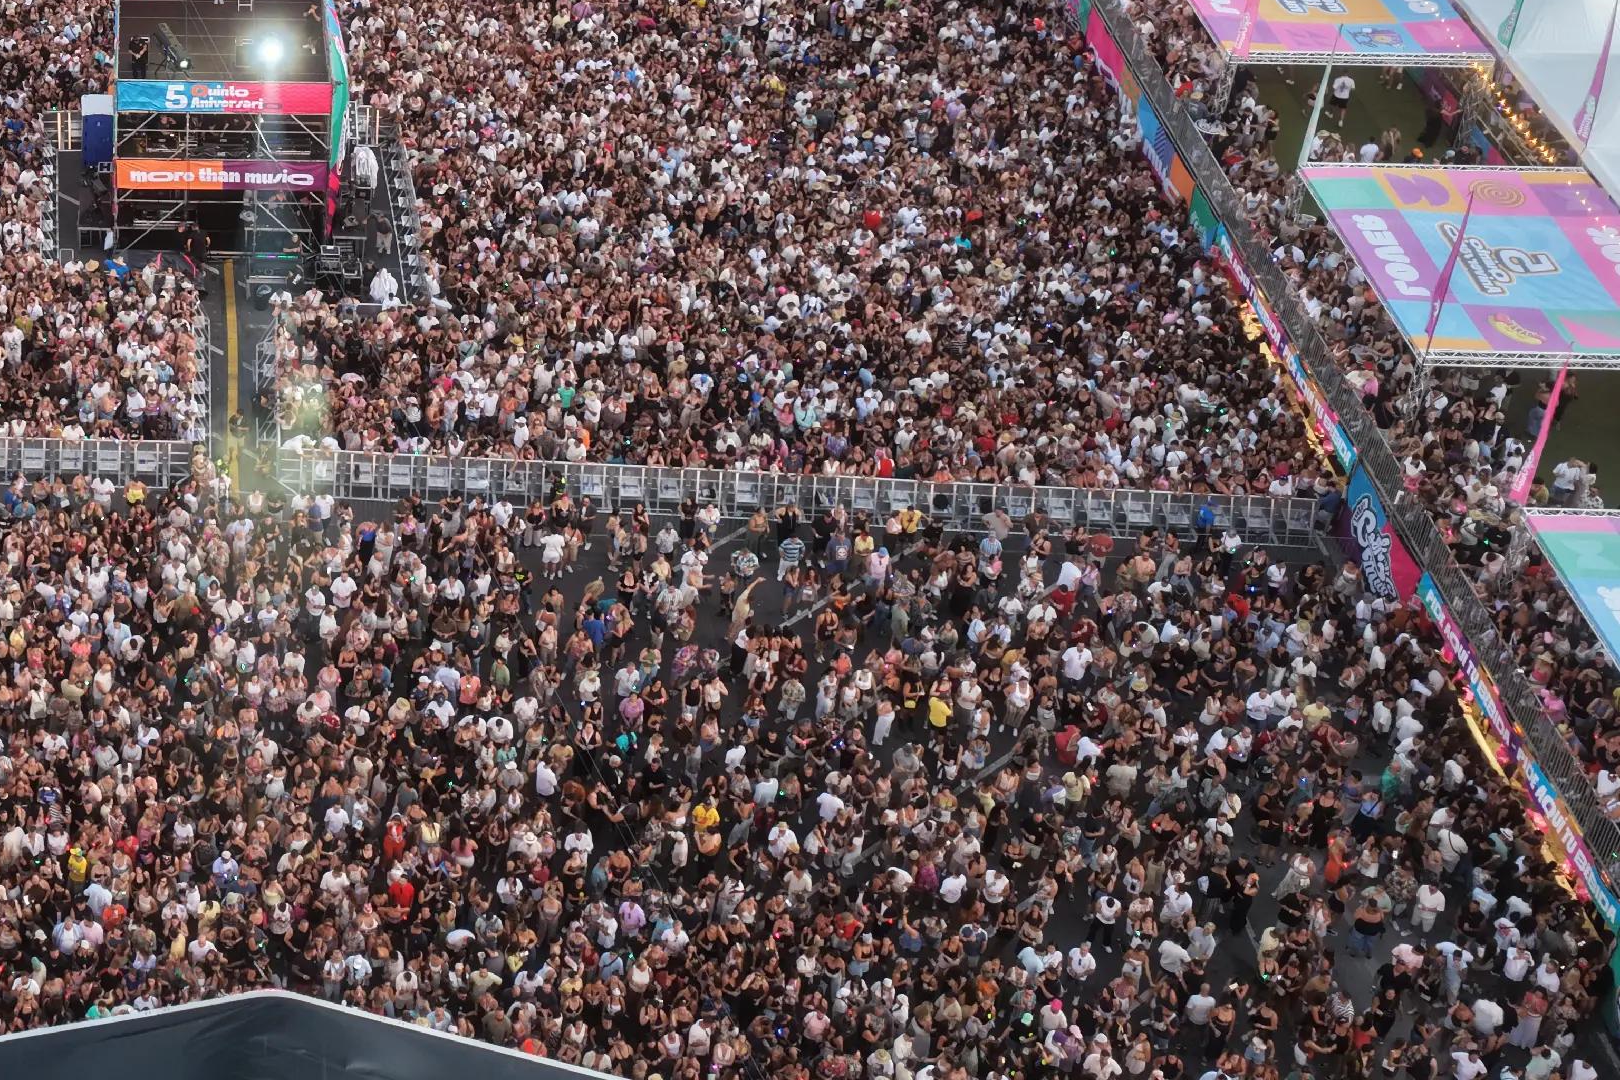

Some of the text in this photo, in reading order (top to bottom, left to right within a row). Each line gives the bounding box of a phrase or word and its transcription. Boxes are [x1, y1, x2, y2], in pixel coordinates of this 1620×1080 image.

[165, 85, 188, 109] 5
[191, 84, 249, 98] Quinto
[130, 169, 195, 183] more
[198, 168, 240, 183] than
[1351, 214, 1430, 297] LOVER
[1465, 659, 1480, 684] TU
[1474, 680, 1514, 746] BEBIDA
[1534, 782, 1568, 833] AQUÍ
[1560, 826, 1578, 853] TU
[1572, 848, 1618, 924] BEBIDA
